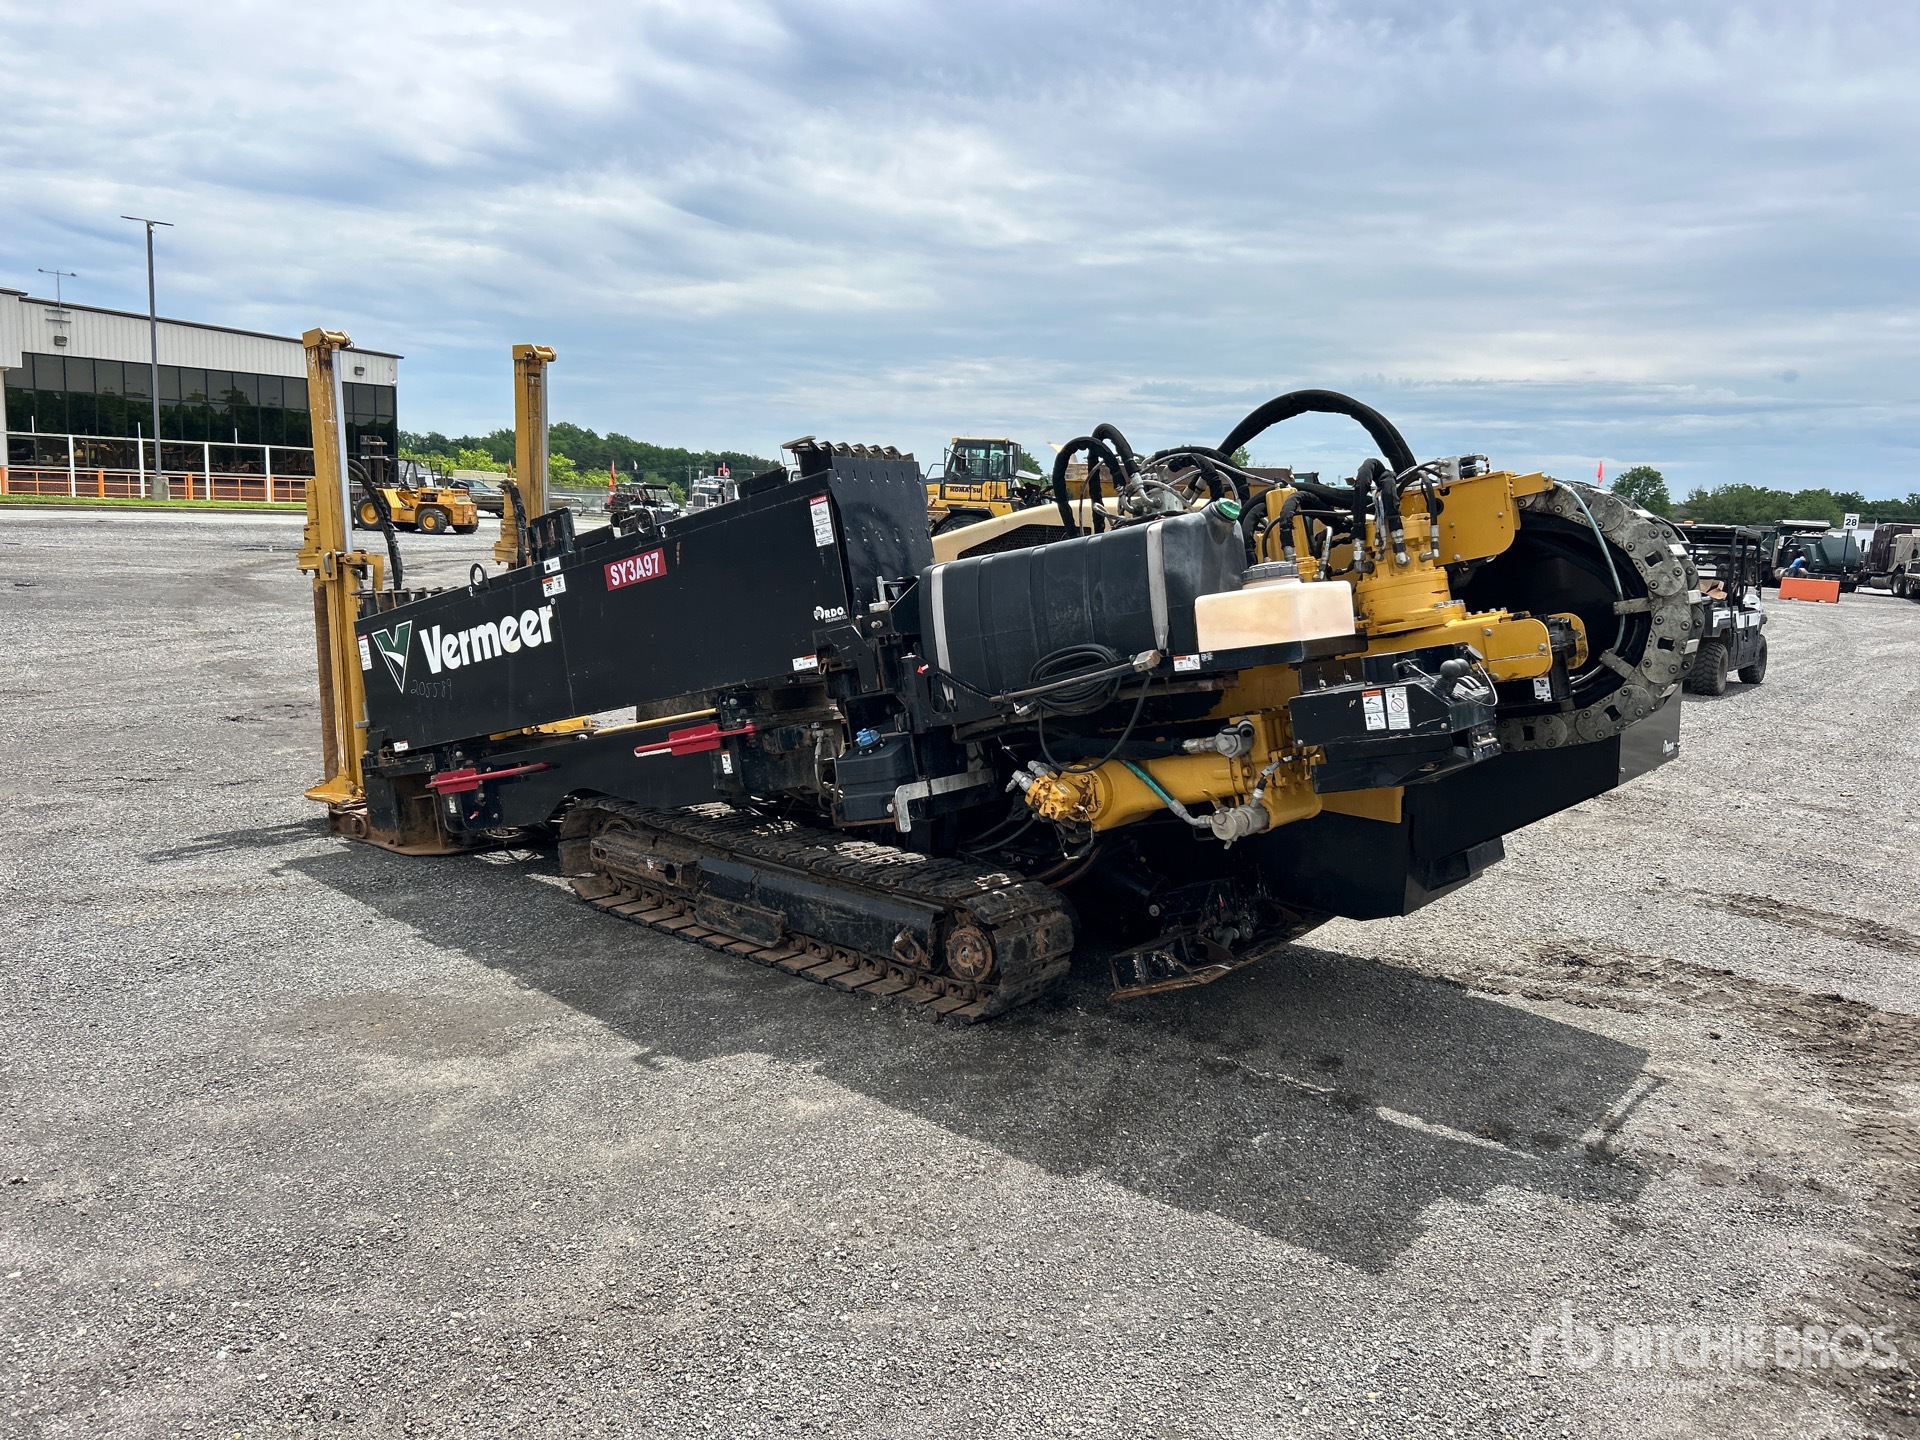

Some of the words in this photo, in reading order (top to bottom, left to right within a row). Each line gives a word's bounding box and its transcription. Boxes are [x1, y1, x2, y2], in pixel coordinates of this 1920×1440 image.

[1845, 518, 1857, 527] 28
[610, 552, 659, 586] SY3A97
[418, 604, 554, 675] Vermeer
[410, 678, 453, 700] 205589
